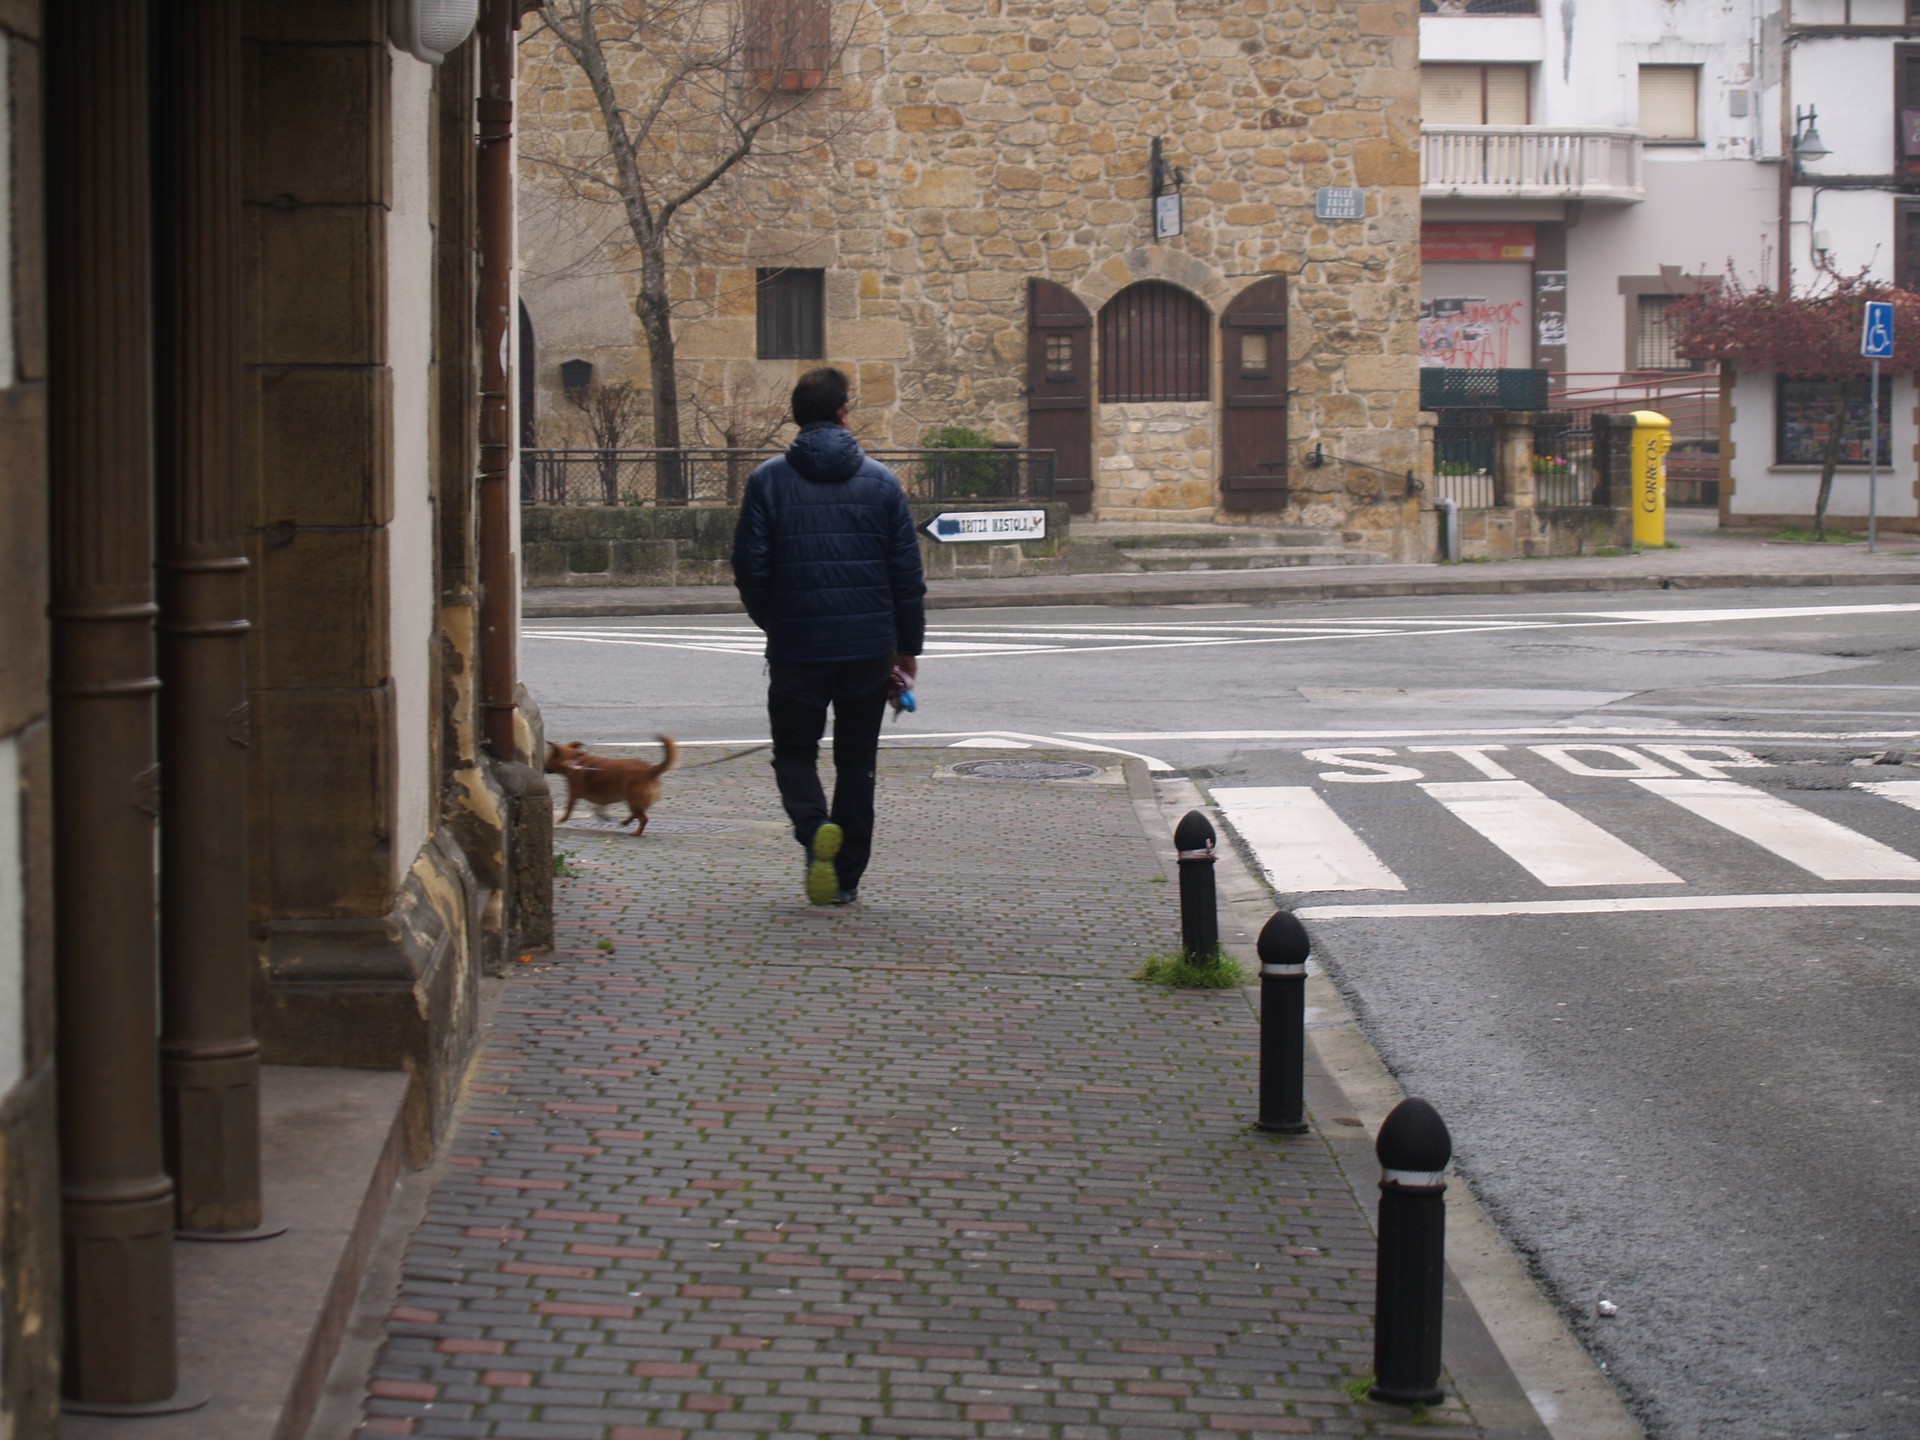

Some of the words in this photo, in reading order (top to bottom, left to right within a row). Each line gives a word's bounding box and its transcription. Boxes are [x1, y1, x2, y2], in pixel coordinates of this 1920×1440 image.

[1327, 189, 1354, 198] CALLE
[1641, 439, 1658, 513] CORREOS
[992, 518, 1029, 532] IKASTOLA
[1300, 744, 1779, 783] STOP
